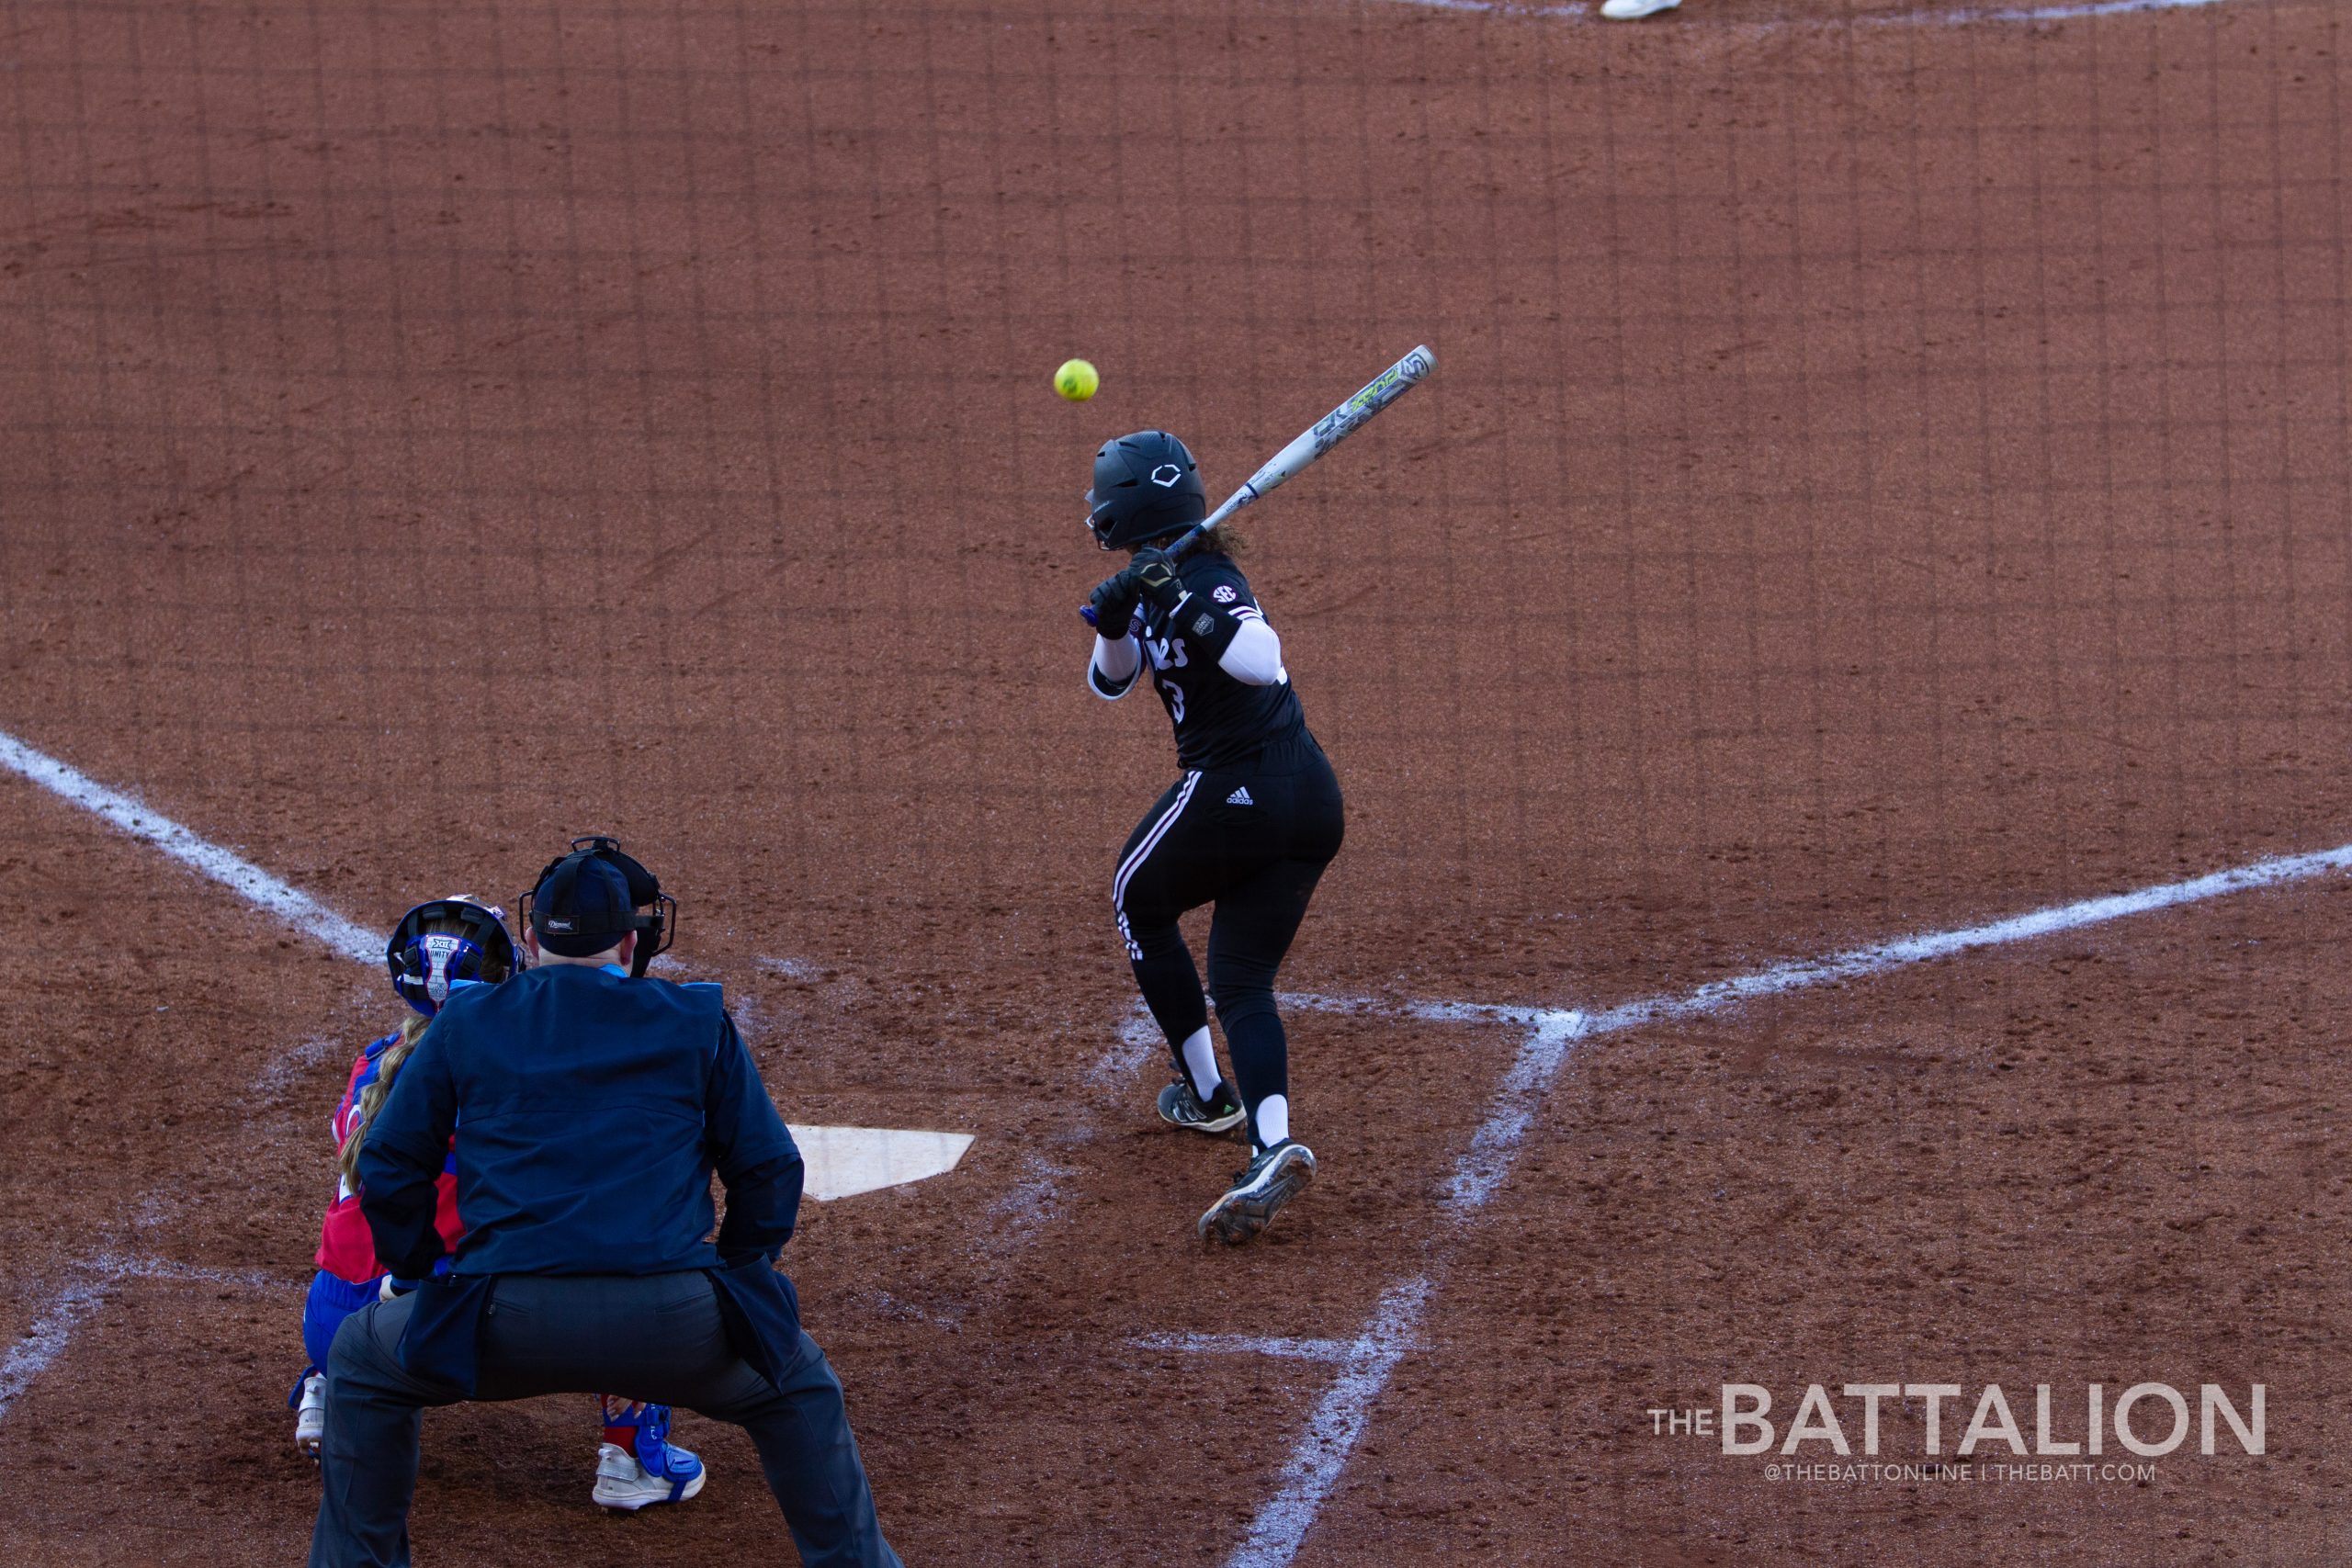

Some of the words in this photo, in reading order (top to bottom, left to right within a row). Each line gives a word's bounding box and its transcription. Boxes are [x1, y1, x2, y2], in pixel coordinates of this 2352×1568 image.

[1213, 585, 1237, 603] SEC
[1145, 626, 1188, 671] ies
[1161, 679, 1185, 725] 3
[1226, 796, 1254, 806] adidas
[430, 949, 450, 959] UNITY
